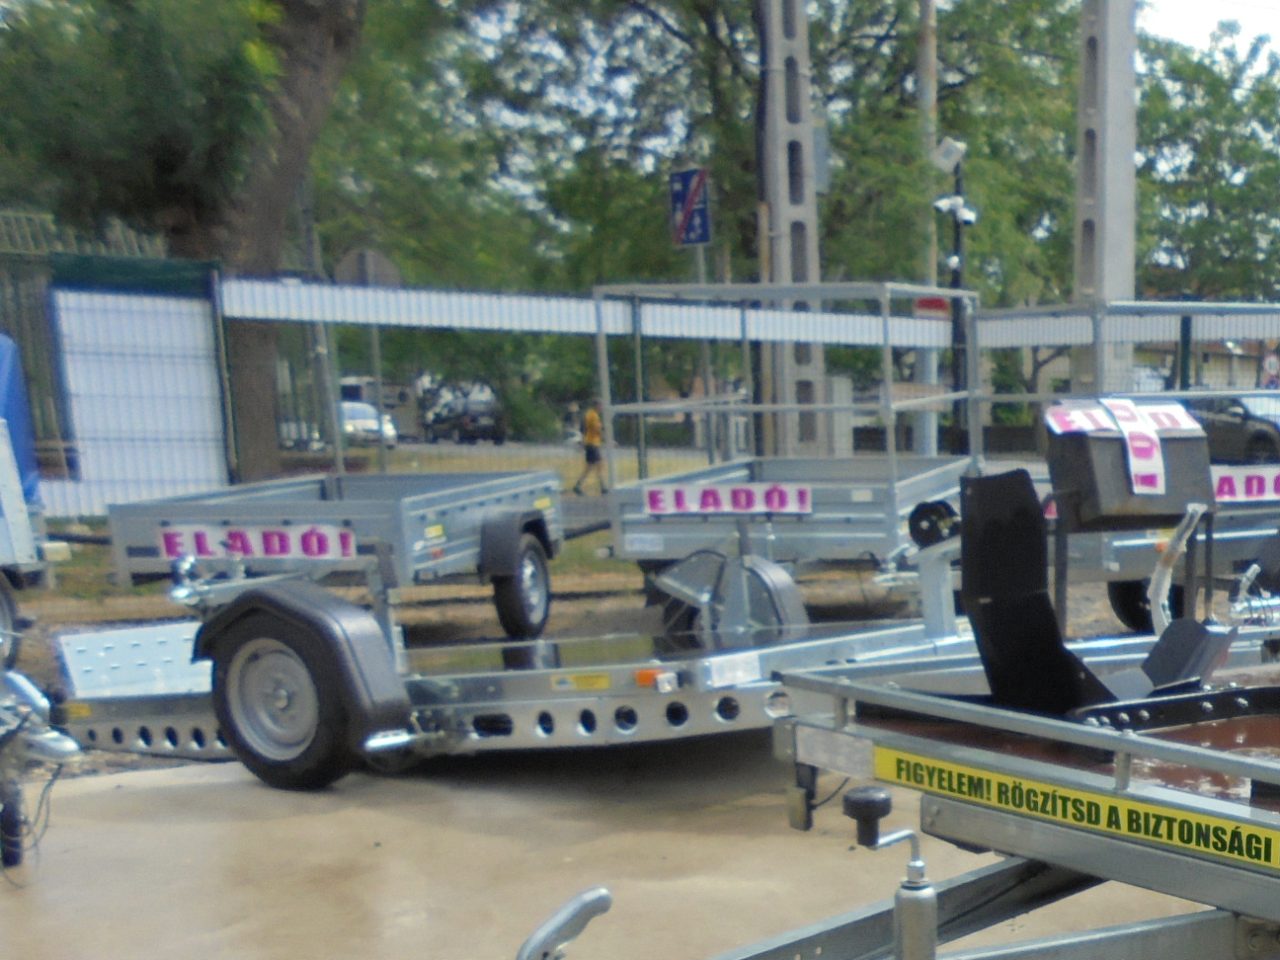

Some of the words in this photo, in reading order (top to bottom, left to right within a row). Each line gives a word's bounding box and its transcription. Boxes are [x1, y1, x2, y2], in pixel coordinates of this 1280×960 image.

[648, 485, 809, 512] ELADÓ!
[162, 525, 354, 558] ELADÓ!
[896, 758, 992, 800] FIGYELEM!
[997, 781, 1100, 826] RÖGZÍTSD
[1106, 806, 1121, 830] A
[1127, 808, 1272, 863] BIZTONSÁGI
